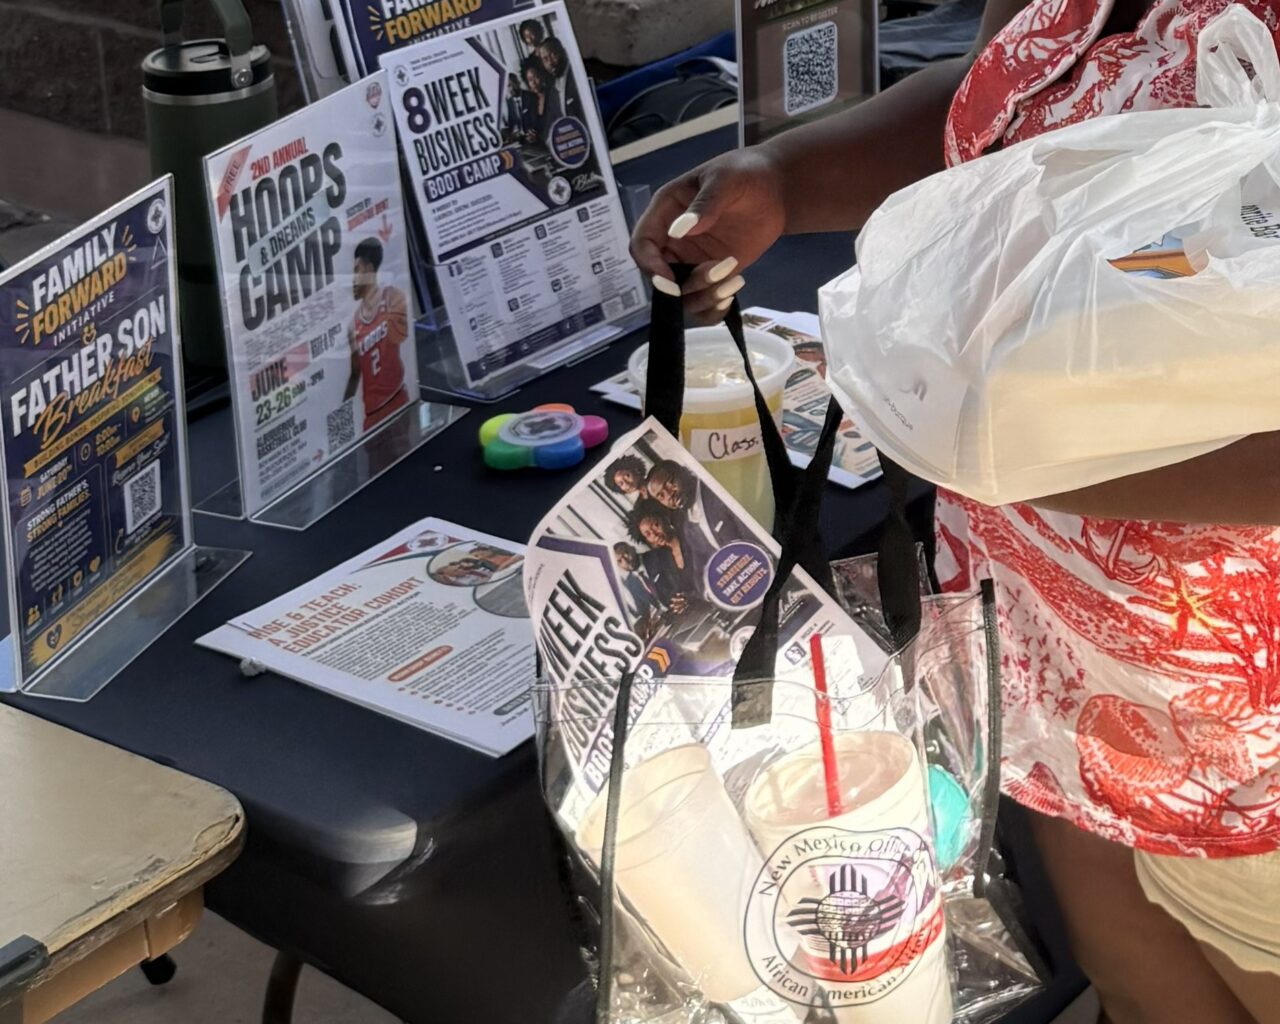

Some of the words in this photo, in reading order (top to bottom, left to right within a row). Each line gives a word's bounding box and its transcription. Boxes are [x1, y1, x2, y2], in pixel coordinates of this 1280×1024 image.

[402, 87, 431, 134] 8
[424, 67, 490, 125] WEEK
[250, 160, 271, 180] 2ND
[272, 137, 309, 166] ANNUAL
[413, 113, 501, 176] BUSINESS
[229, 142, 347, 264] HOOPS
[427, 169, 463, 200] BOOT
[463, 154, 502, 182] CAMP
[32, 221, 118, 311] FAMILY
[260, 247, 269, 265] &
[271, 207, 316, 256] DREAMS
[32, 251, 127, 345] FORWARD
[239, 216, 342, 331] CAMP
[53, 293, 115, 347] INITIATIVE
[11, 331, 113, 437] FATHER
[118, 295, 166, 359] SON
[33, 335, 156, 449] Breakfast
[251, 357, 288, 403] JUNE
[255, 386, 292, 426] 23-26
[27, 503, 55, 531] STRONG
[27, 513, 57, 543] STRONG
[248, 618, 292, 640] RISE
[300, 582, 362, 612] TEACH:
[267, 637, 288, 648] A
[286, 601, 352, 639] JUSTICE
[283, 608, 368, 654] EDUCATOR
[364, 576, 425, 611] COHORT
[540, 568, 606, 682] WEEK
[759, 853, 792, 896] New
[794, 833, 861, 855] Mexico
[762, 954, 810, 998] African
